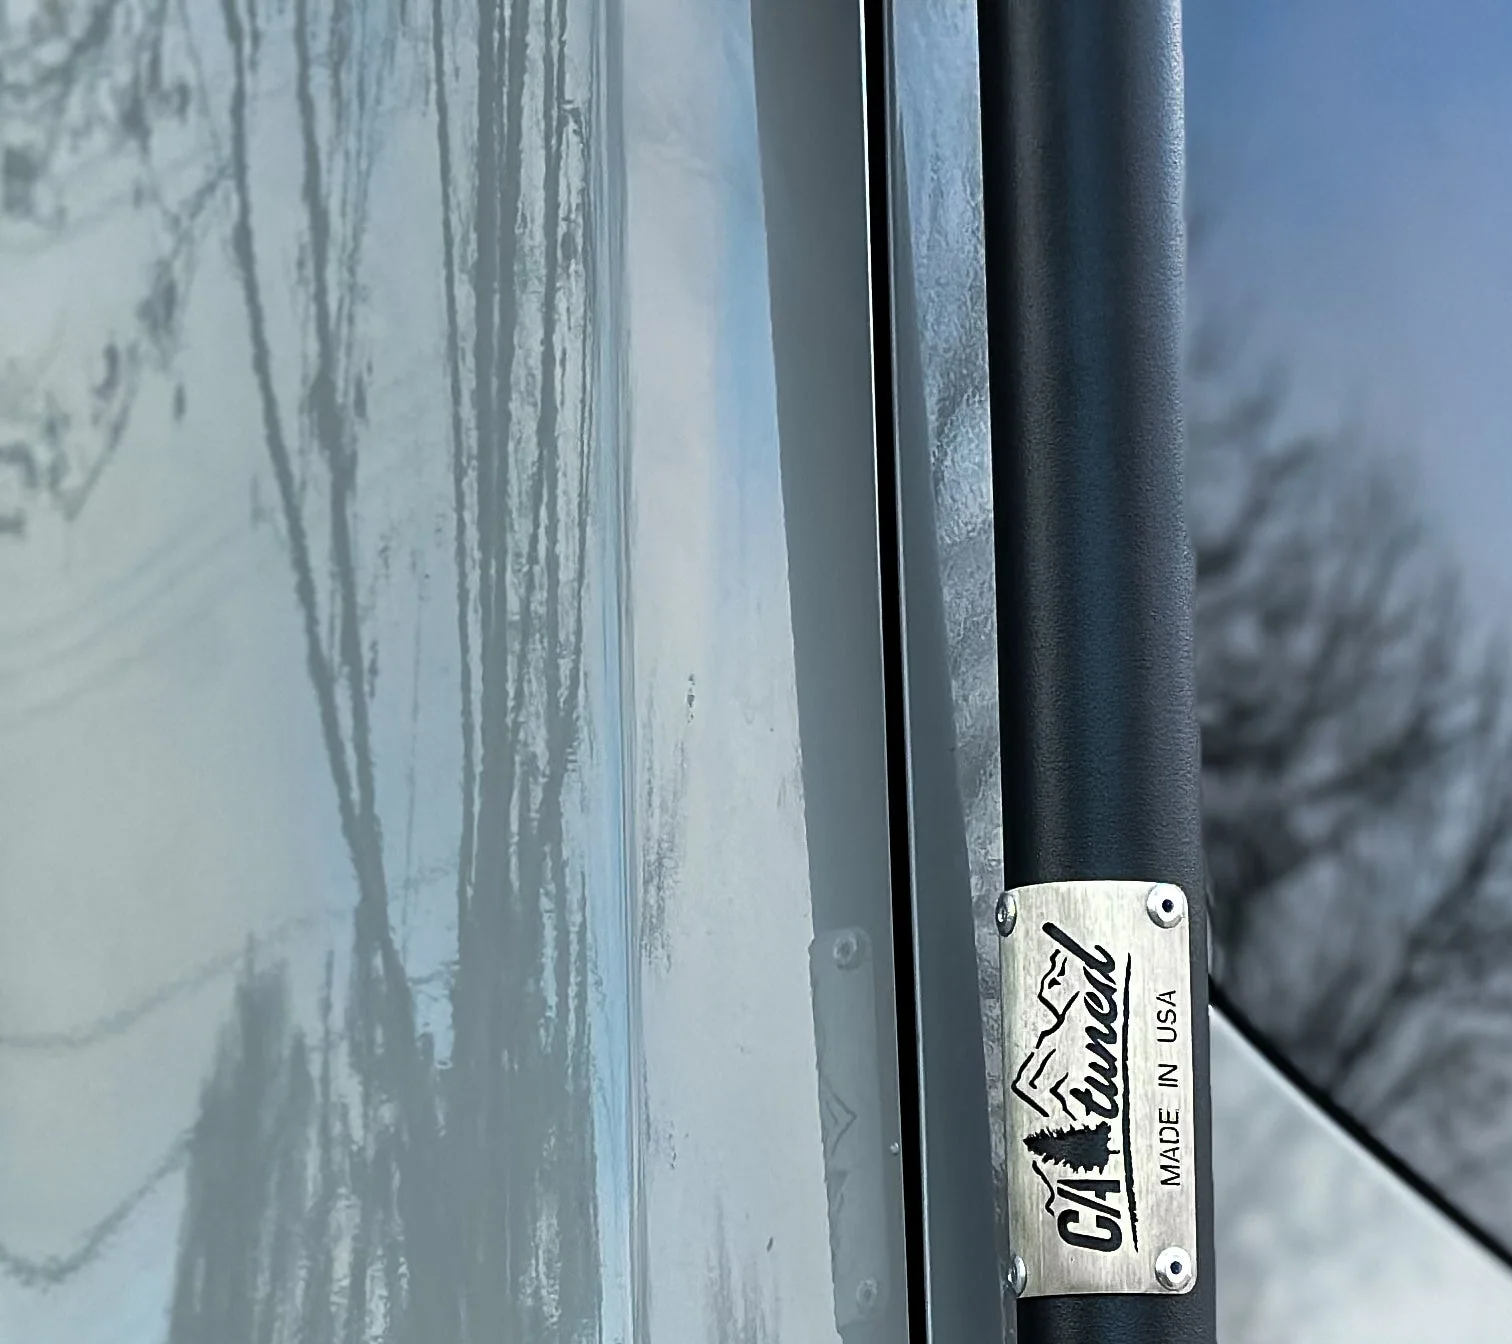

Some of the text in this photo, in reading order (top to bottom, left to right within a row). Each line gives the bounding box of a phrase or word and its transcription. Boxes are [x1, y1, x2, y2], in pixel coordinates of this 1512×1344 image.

[1154, 989, 1182, 1186] MADE IN USA
